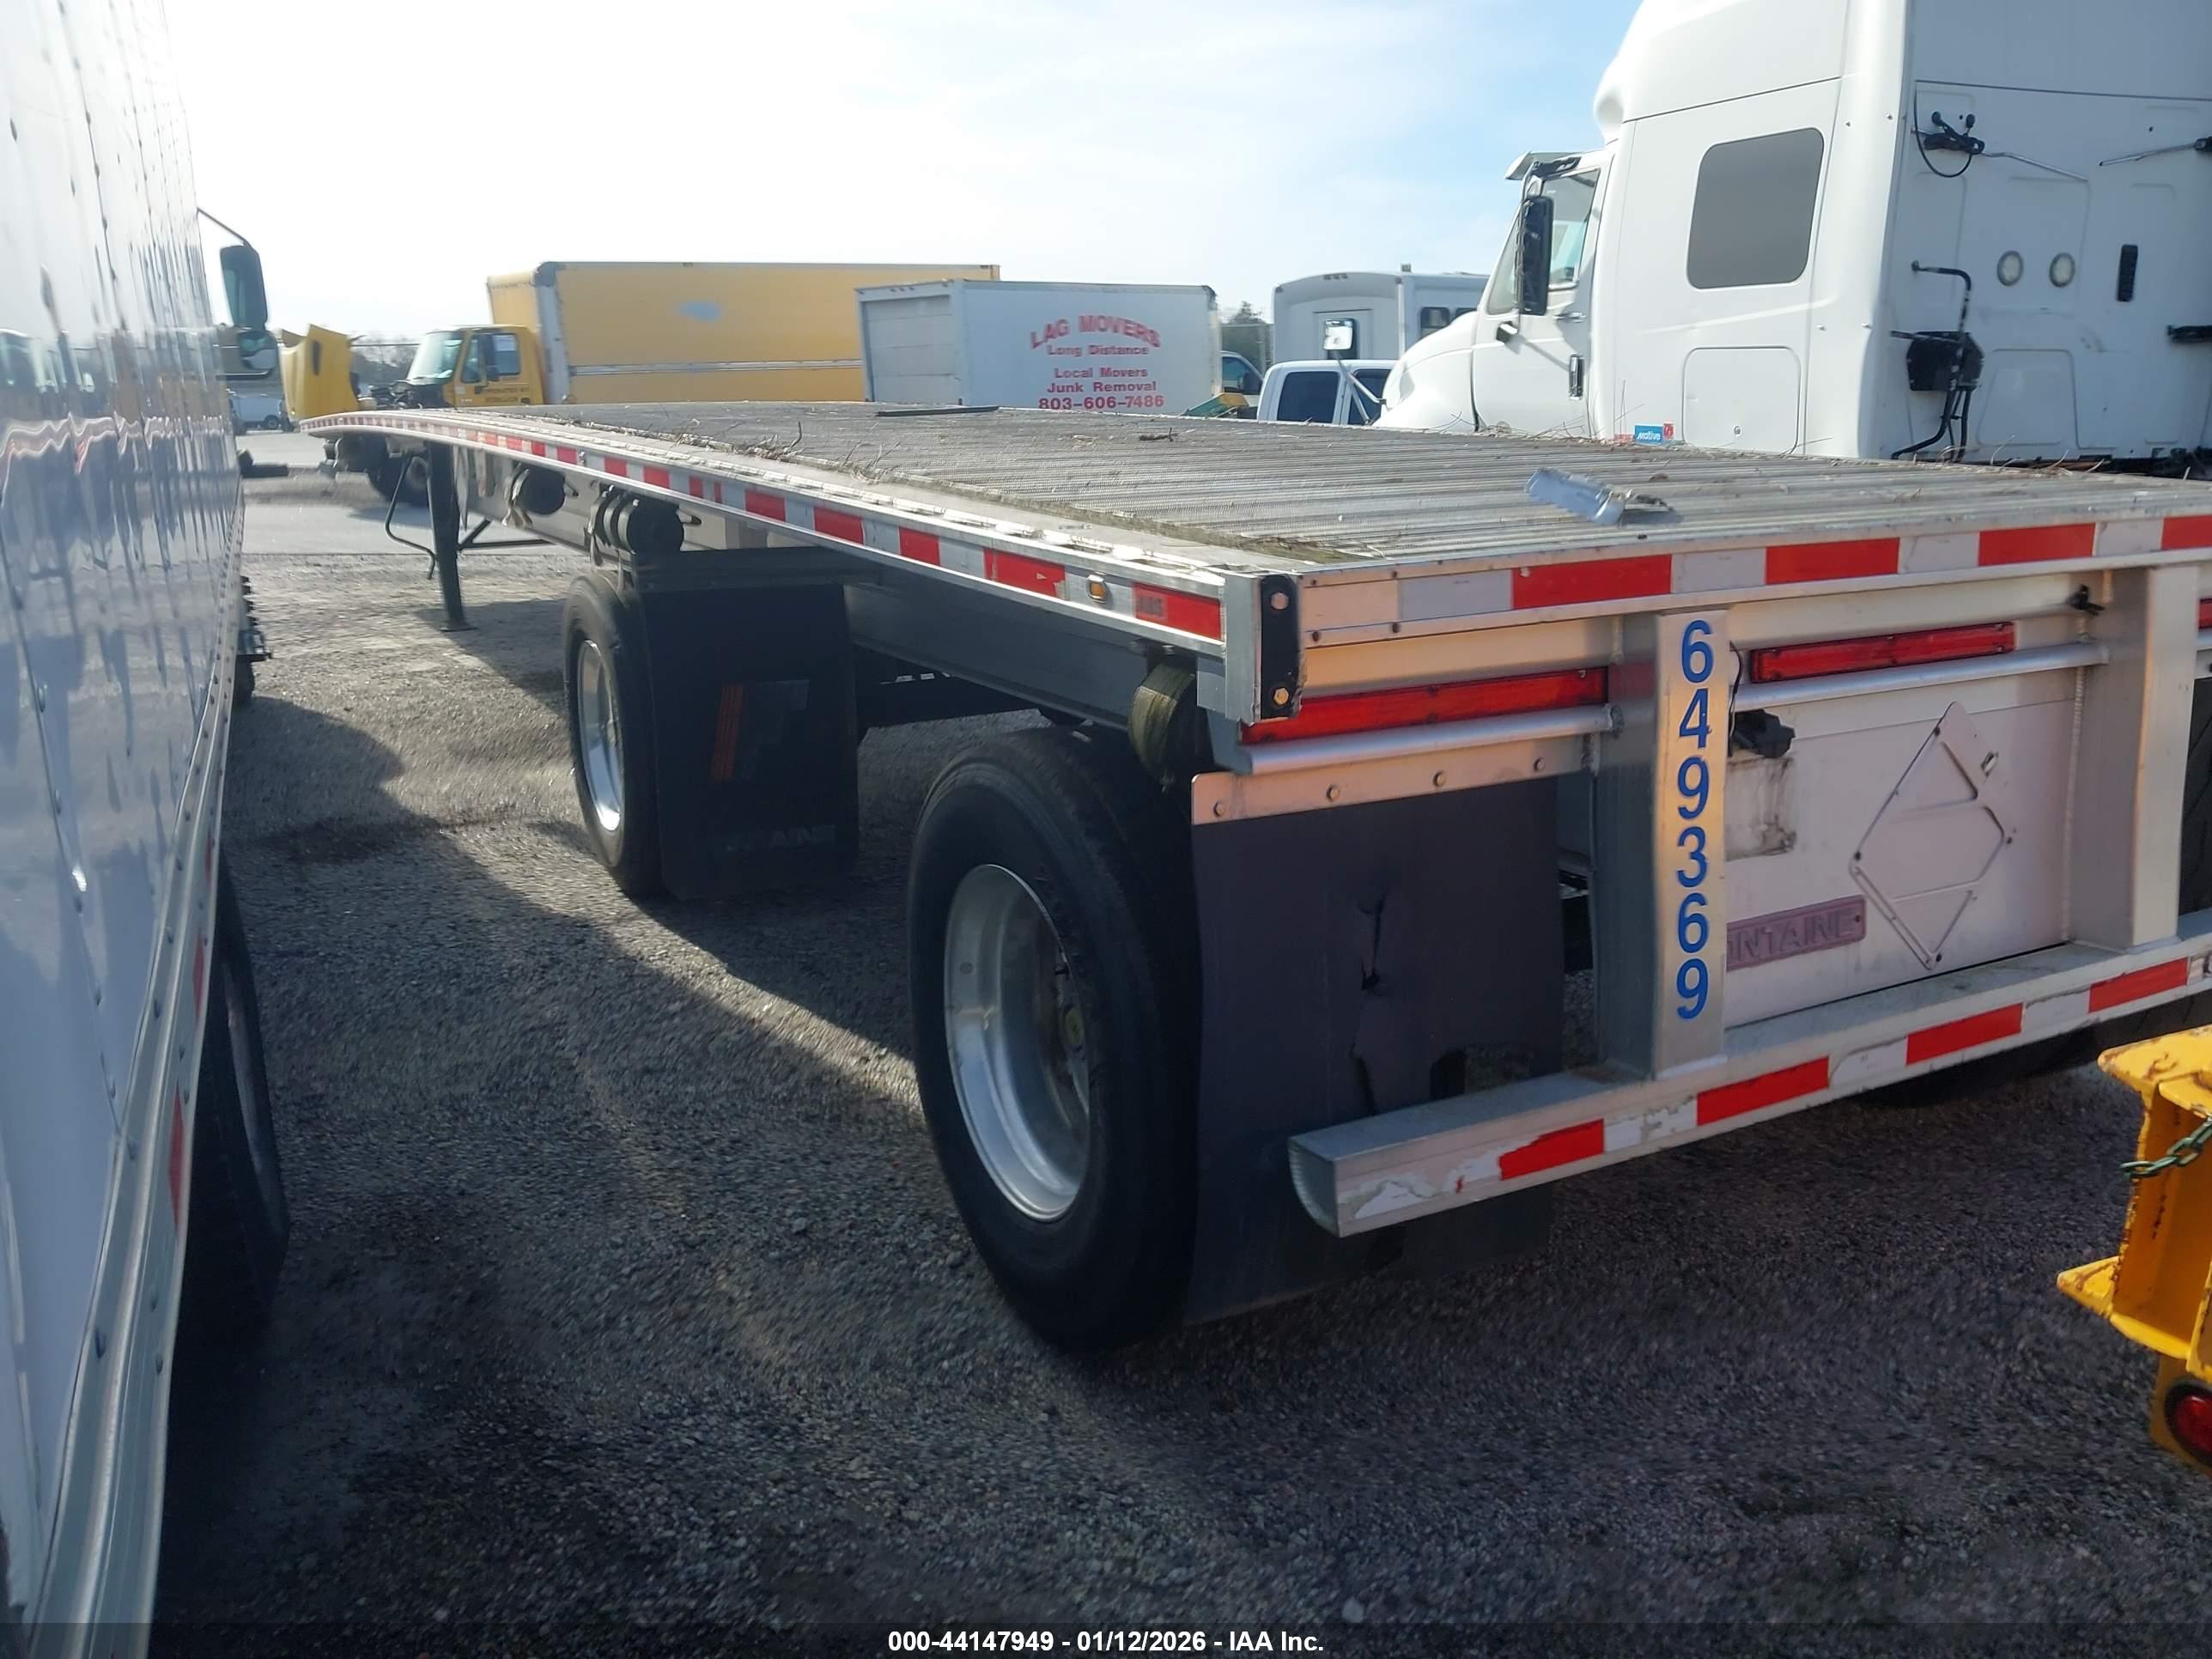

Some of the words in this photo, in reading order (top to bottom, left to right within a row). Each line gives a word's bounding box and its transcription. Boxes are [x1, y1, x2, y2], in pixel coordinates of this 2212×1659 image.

[1030, 319, 1070, 349] LAG
[1078, 315, 1161, 348] MOVERS
[1046, 345, 1083, 356] Long
[1088, 344, 1150, 356] Distance
[1054, 368, 1093, 378] Local
[1099, 367, 1148, 377] Movers
[1047, 382, 1084, 392] Junk
[1093, 380, 1157, 392] Removal
[1038, 395, 1164, 410] 803-606-7486
[1676, 620, 1713, 1019] 649369
